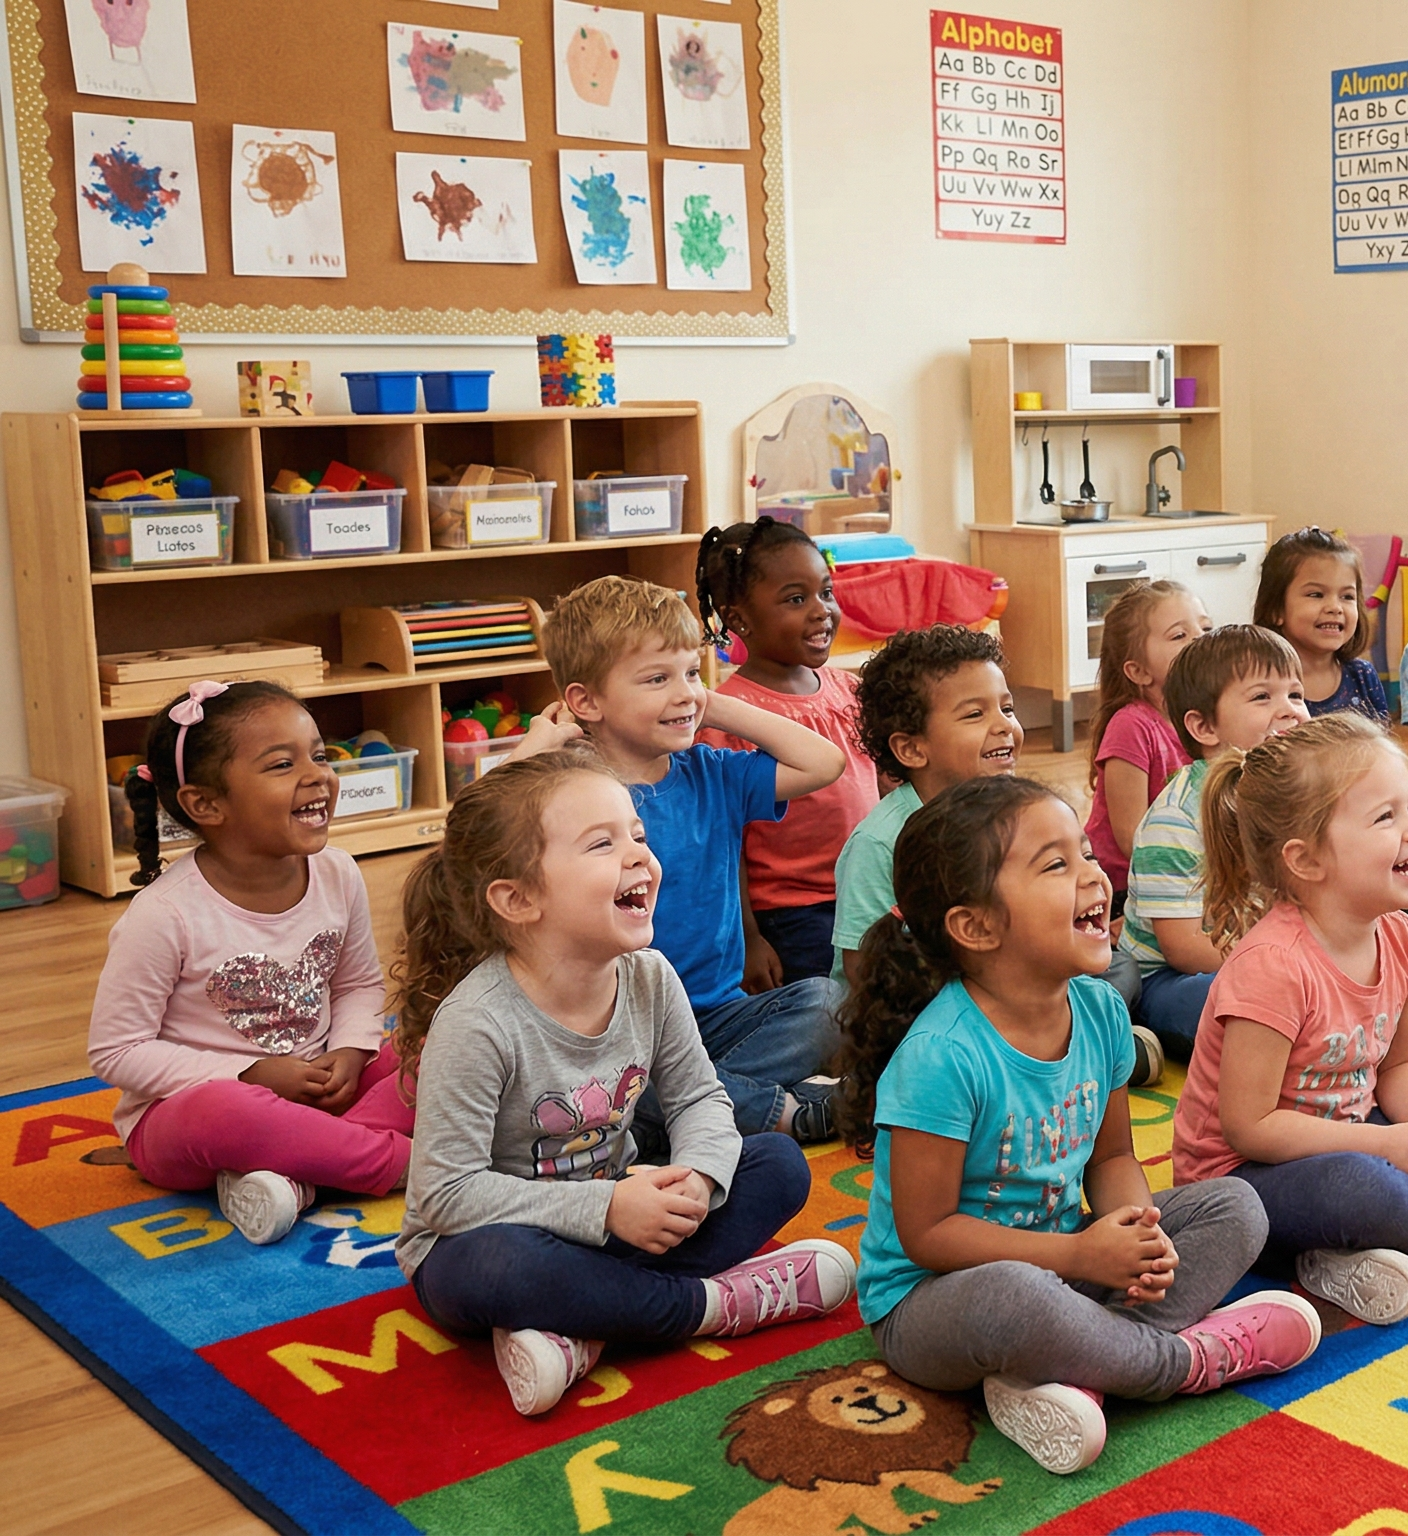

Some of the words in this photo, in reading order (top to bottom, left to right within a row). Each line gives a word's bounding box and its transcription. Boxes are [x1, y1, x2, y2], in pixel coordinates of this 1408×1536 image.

[941, 17, 1053, 56] Alphabet
[939, 52, 964, 72] Aa
[973, 56, 996, 76] Bb
[1004, 60, 1027, 80] Cc
[1035, 64, 1057, 84] Dd
[941, 82, 960, 101] Ff
[971, 86, 997, 111] Gg
[1006, 89, 1030, 109] Hh
[1337, 106, 1359, 122] Aa
[1367, 101, 1388, 119] Bb
[941, 113, 964, 133] Kk
[1001, 120, 1029, 140] Mn
[1035, 123, 1058, 142] Oo
[1358, 129, 1374, 148] Ff
[1376, 128, 1400, 150] Gg
[941, 145, 964, 169] Pp
[973, 148, 998, 172] Qq
[1007, 150, 1030, 169] Ro
[1039, 153, 1058, 172] Sr
[942, 175, 966, 194] Uu
[973, 177, 996, 196] Vv
[1000, 179, 1033, 198] Ww
[1038, 182, 1060, 201] Xx
[1367, 186, 1391, 207] Qq
[972, 208, 1004, 232] Yuy
[1010, 211, 1031, 229] Zz
[1339, 216, 1360, 233] Uu
[1366, 214, 1388, 230] Vv
[326, 521, 371, 534] Toades
[13, 1114, 121, 1167] A
[109, 1207, 235, 1261] B
[267, 1308, 458, 1395] M
